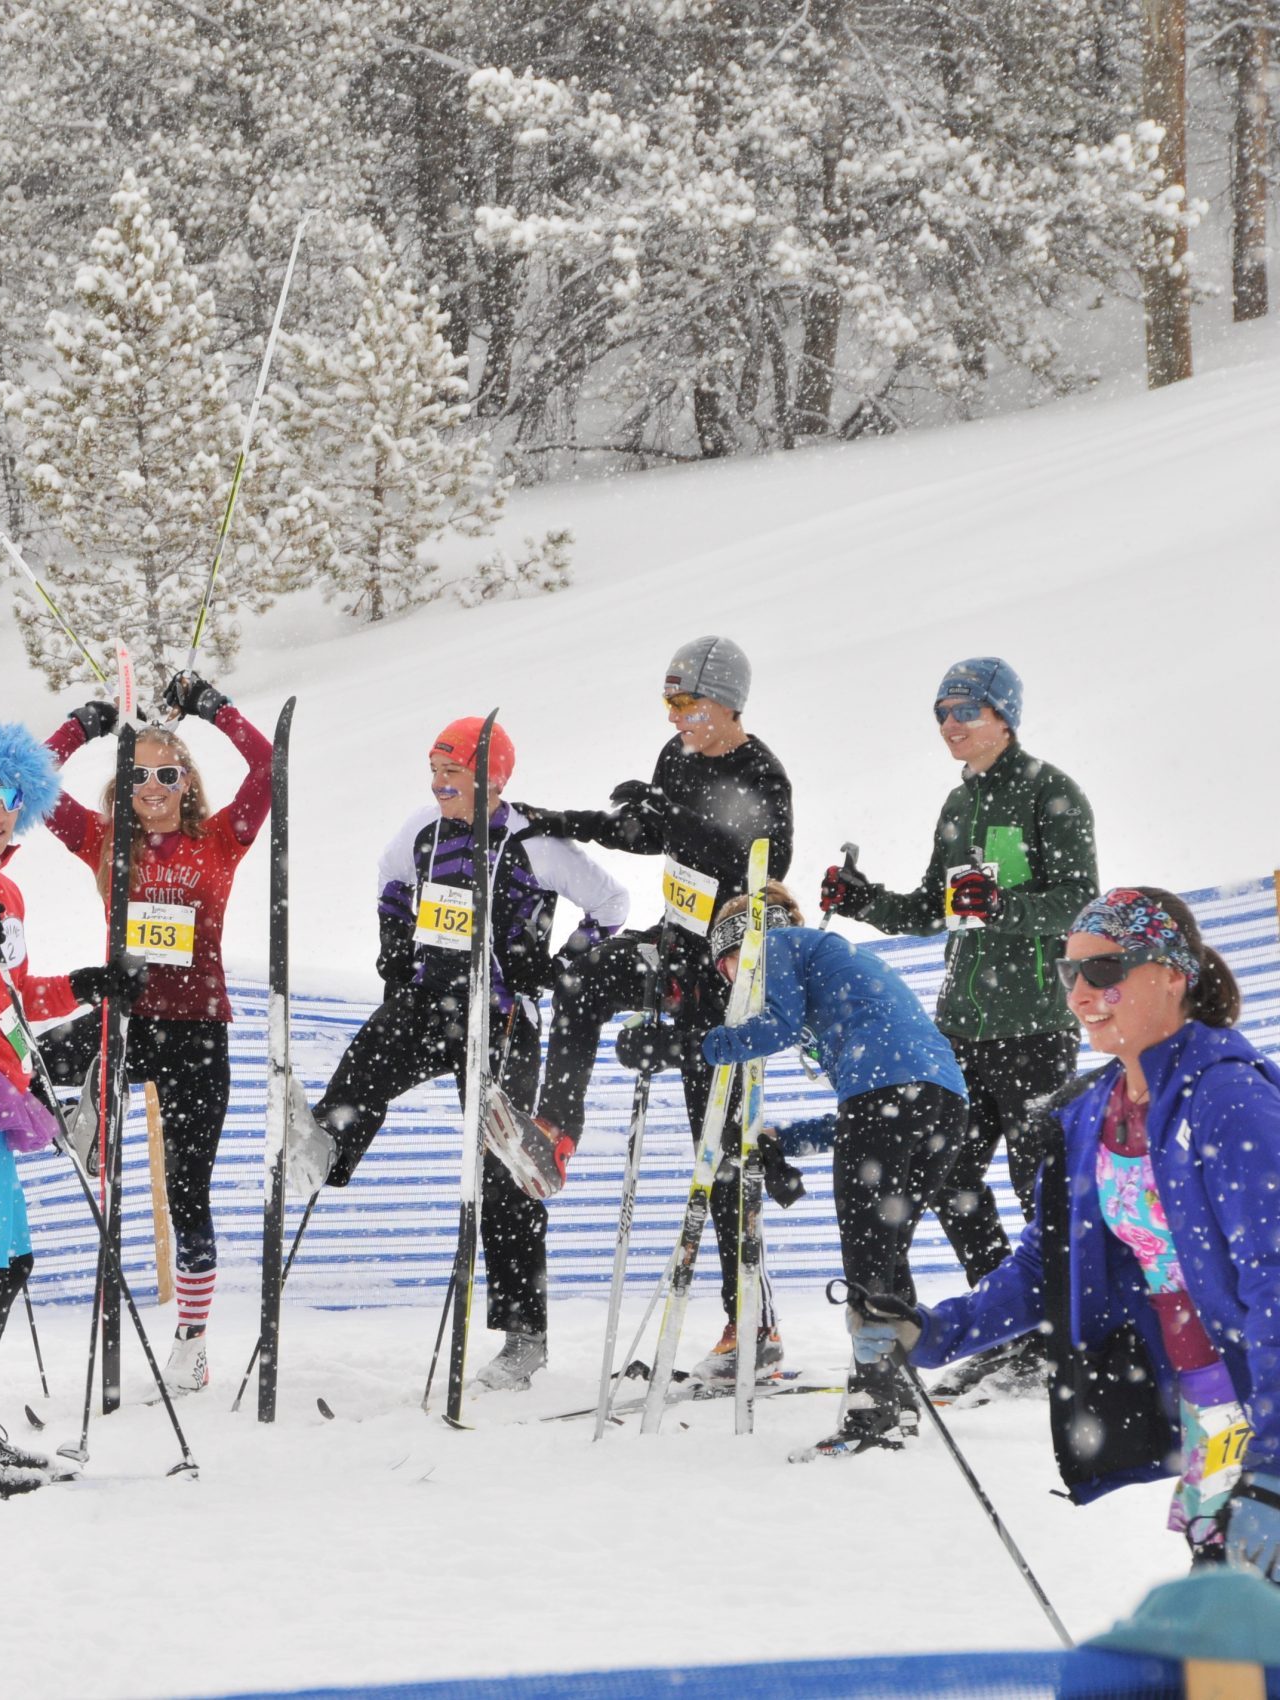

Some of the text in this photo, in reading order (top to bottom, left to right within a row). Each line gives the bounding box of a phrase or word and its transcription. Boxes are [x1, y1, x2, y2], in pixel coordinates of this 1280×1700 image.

[156, 864, 201, 889] UNITED
[145, 886, 184, 905] STATES
[669, 881, 697, 913] 154
[433, 906, 470, 934] 152
[137, 923, 177, 948] 153
[693, 1388, 736, 1401] FISCHE
[1222, 1428, 1250, 1465] 17
